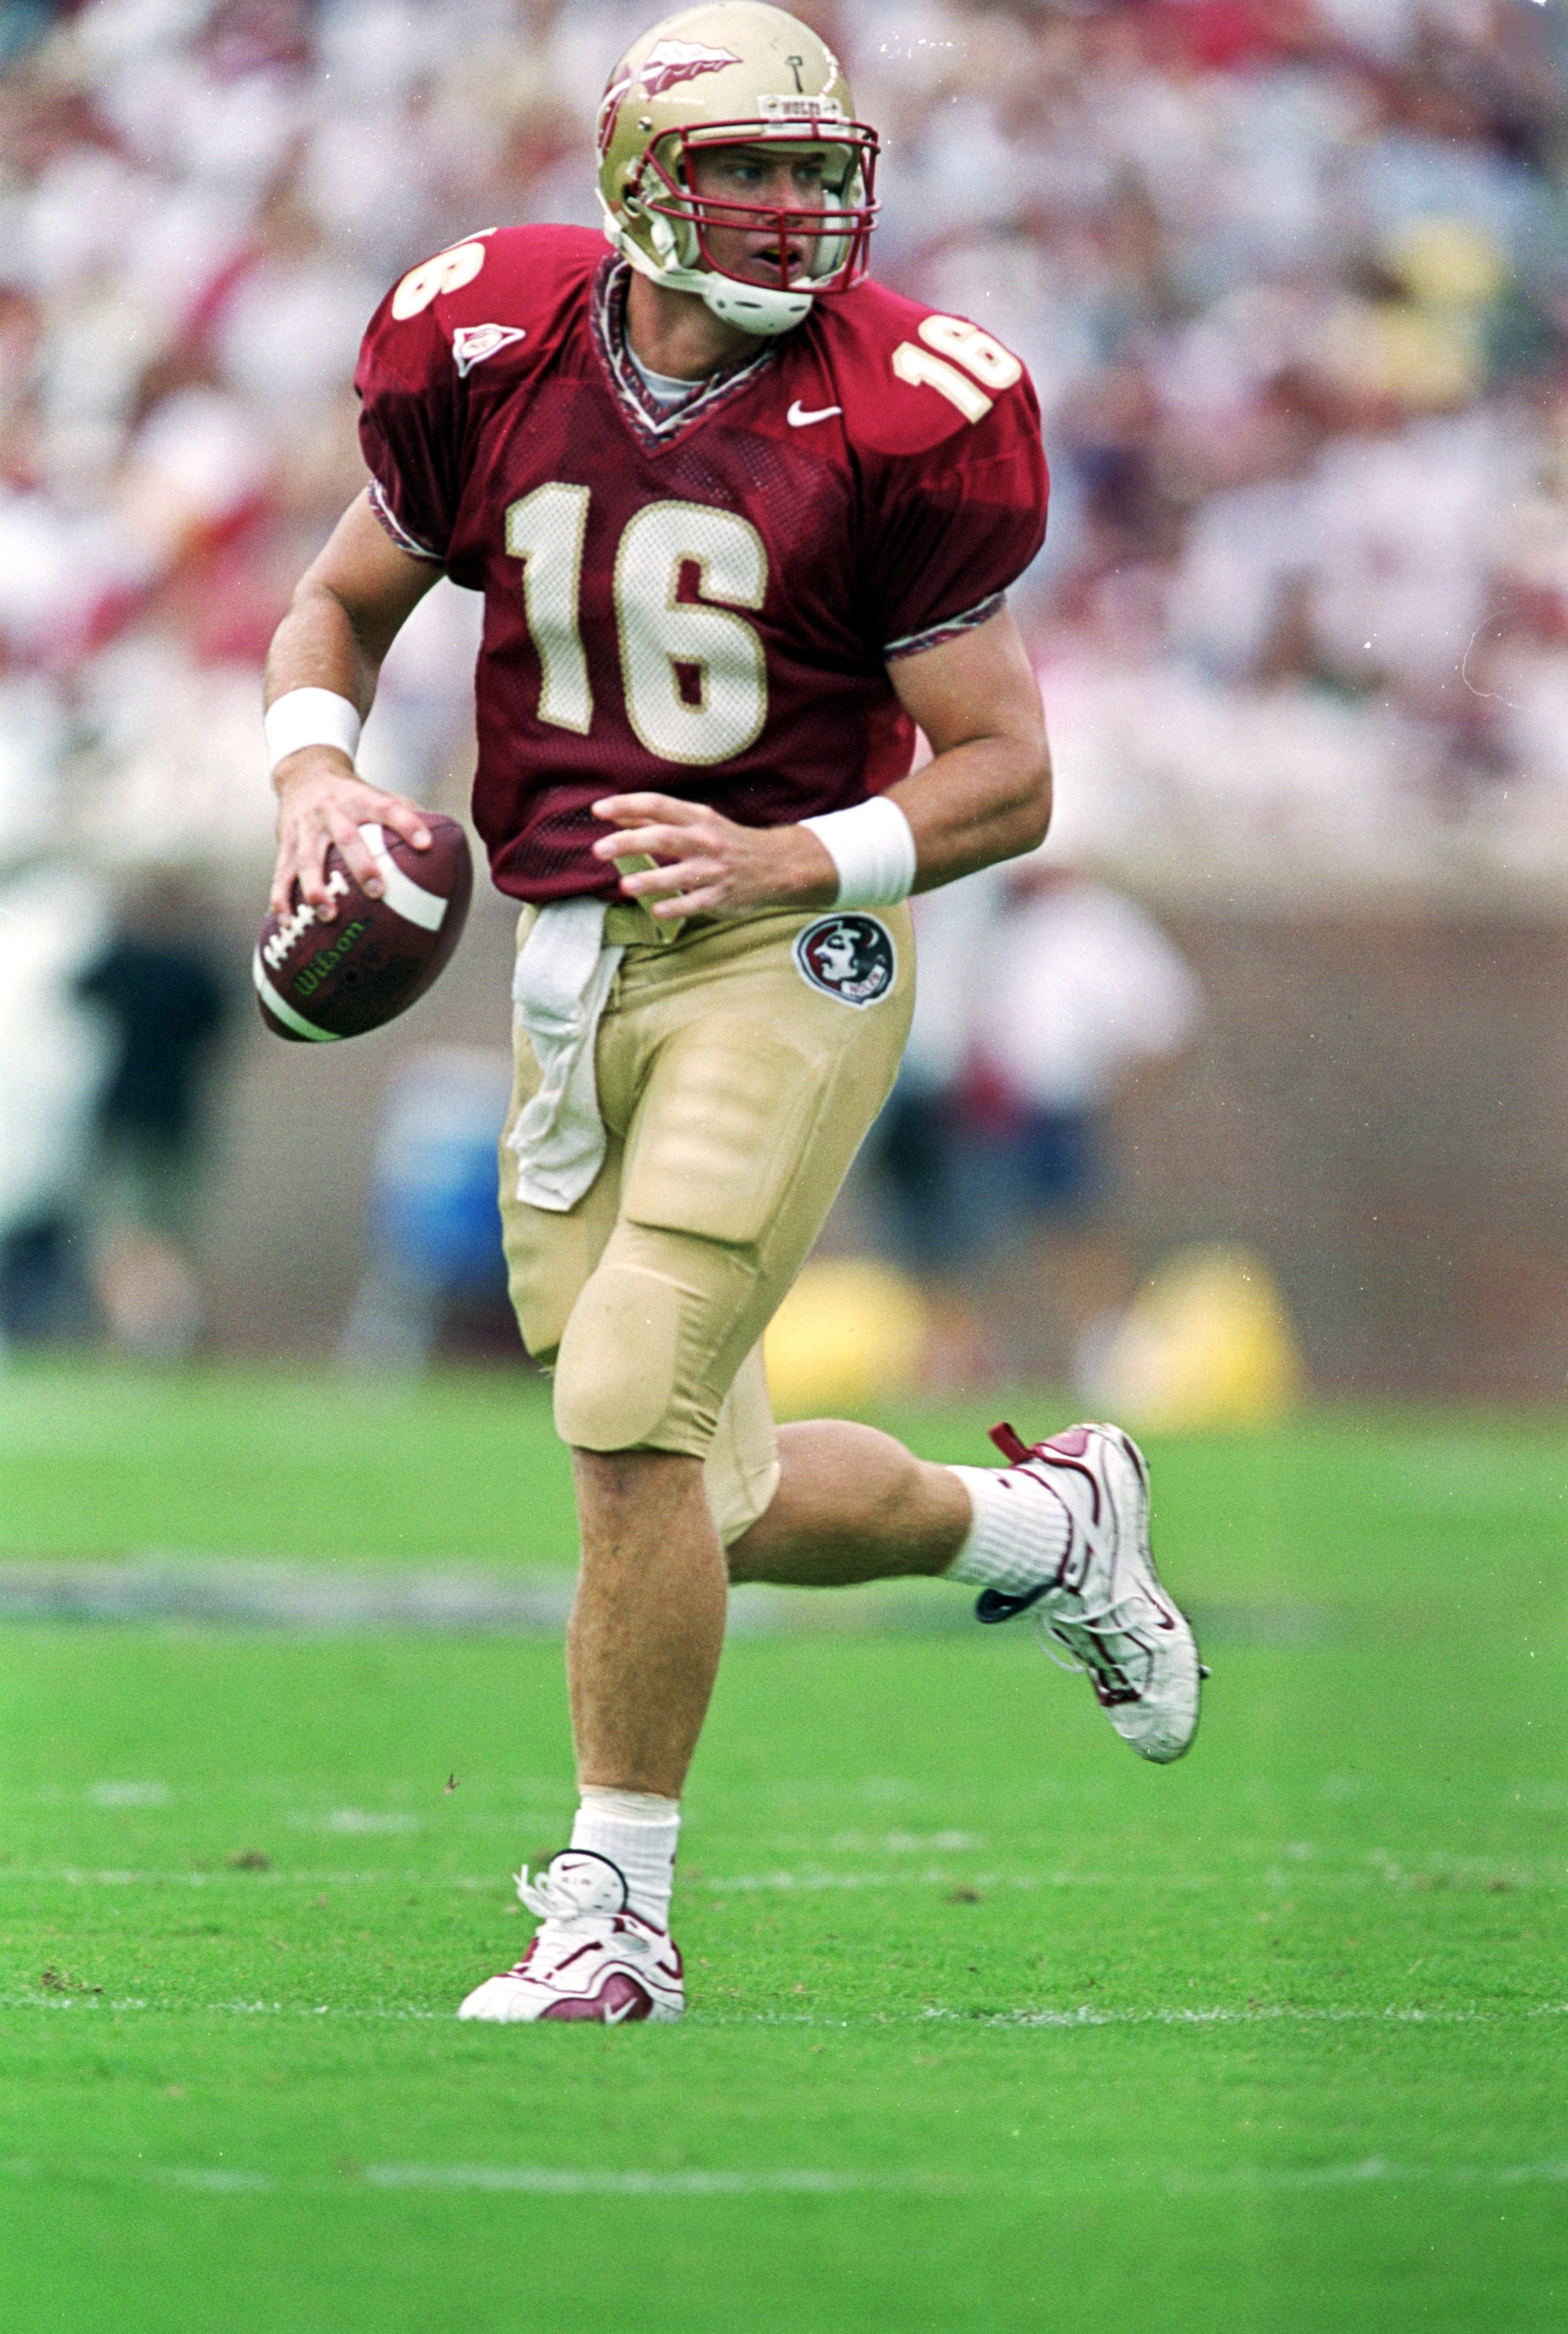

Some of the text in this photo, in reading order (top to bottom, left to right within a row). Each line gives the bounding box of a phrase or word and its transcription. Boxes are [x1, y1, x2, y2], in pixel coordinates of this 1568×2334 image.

[892, 314, 1023, 425] 16
[505, 481, 769, 767] 16
[290, 921, 366, 997] Wilson
